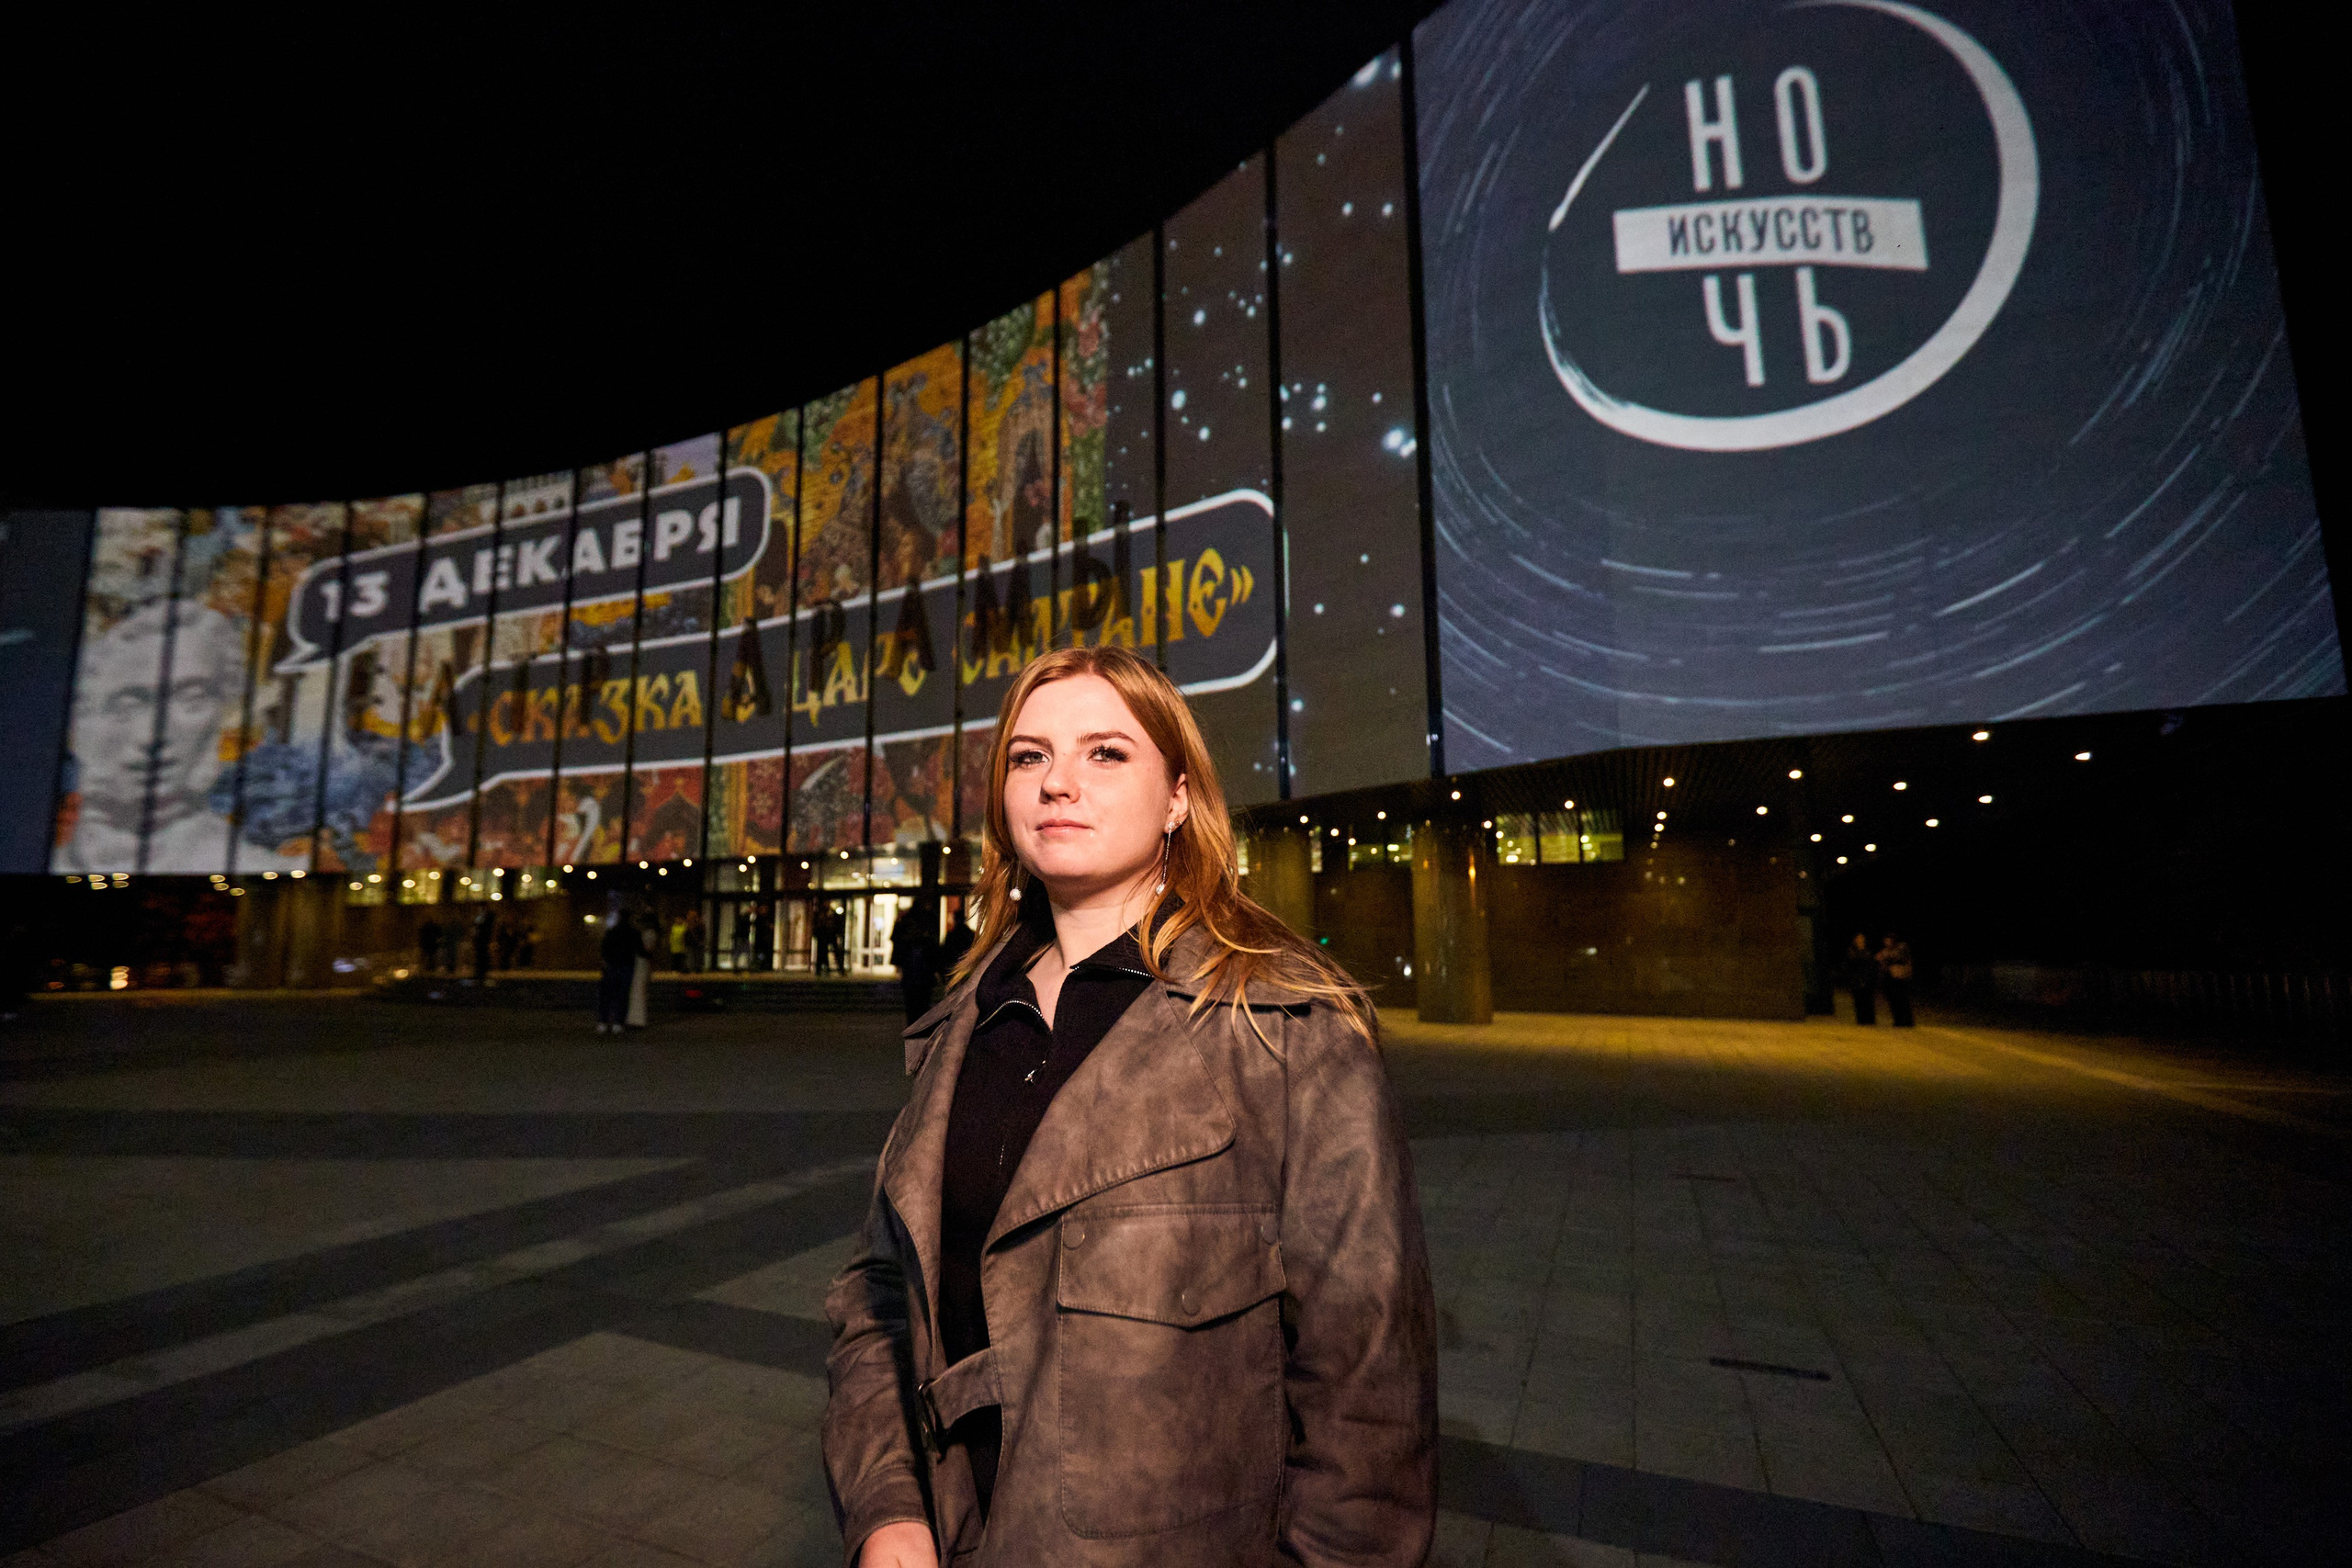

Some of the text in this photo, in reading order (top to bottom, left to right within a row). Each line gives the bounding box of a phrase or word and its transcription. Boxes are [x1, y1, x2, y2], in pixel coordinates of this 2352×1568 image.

[1684, 64, 1828, 192] НО
[1667, 208, 1875, 257] ИСКУССТВ
[1703, 265, 1851, 387] ЧЬ
[319, 496, 741, 623] 13 ДЕКАБРЯ
